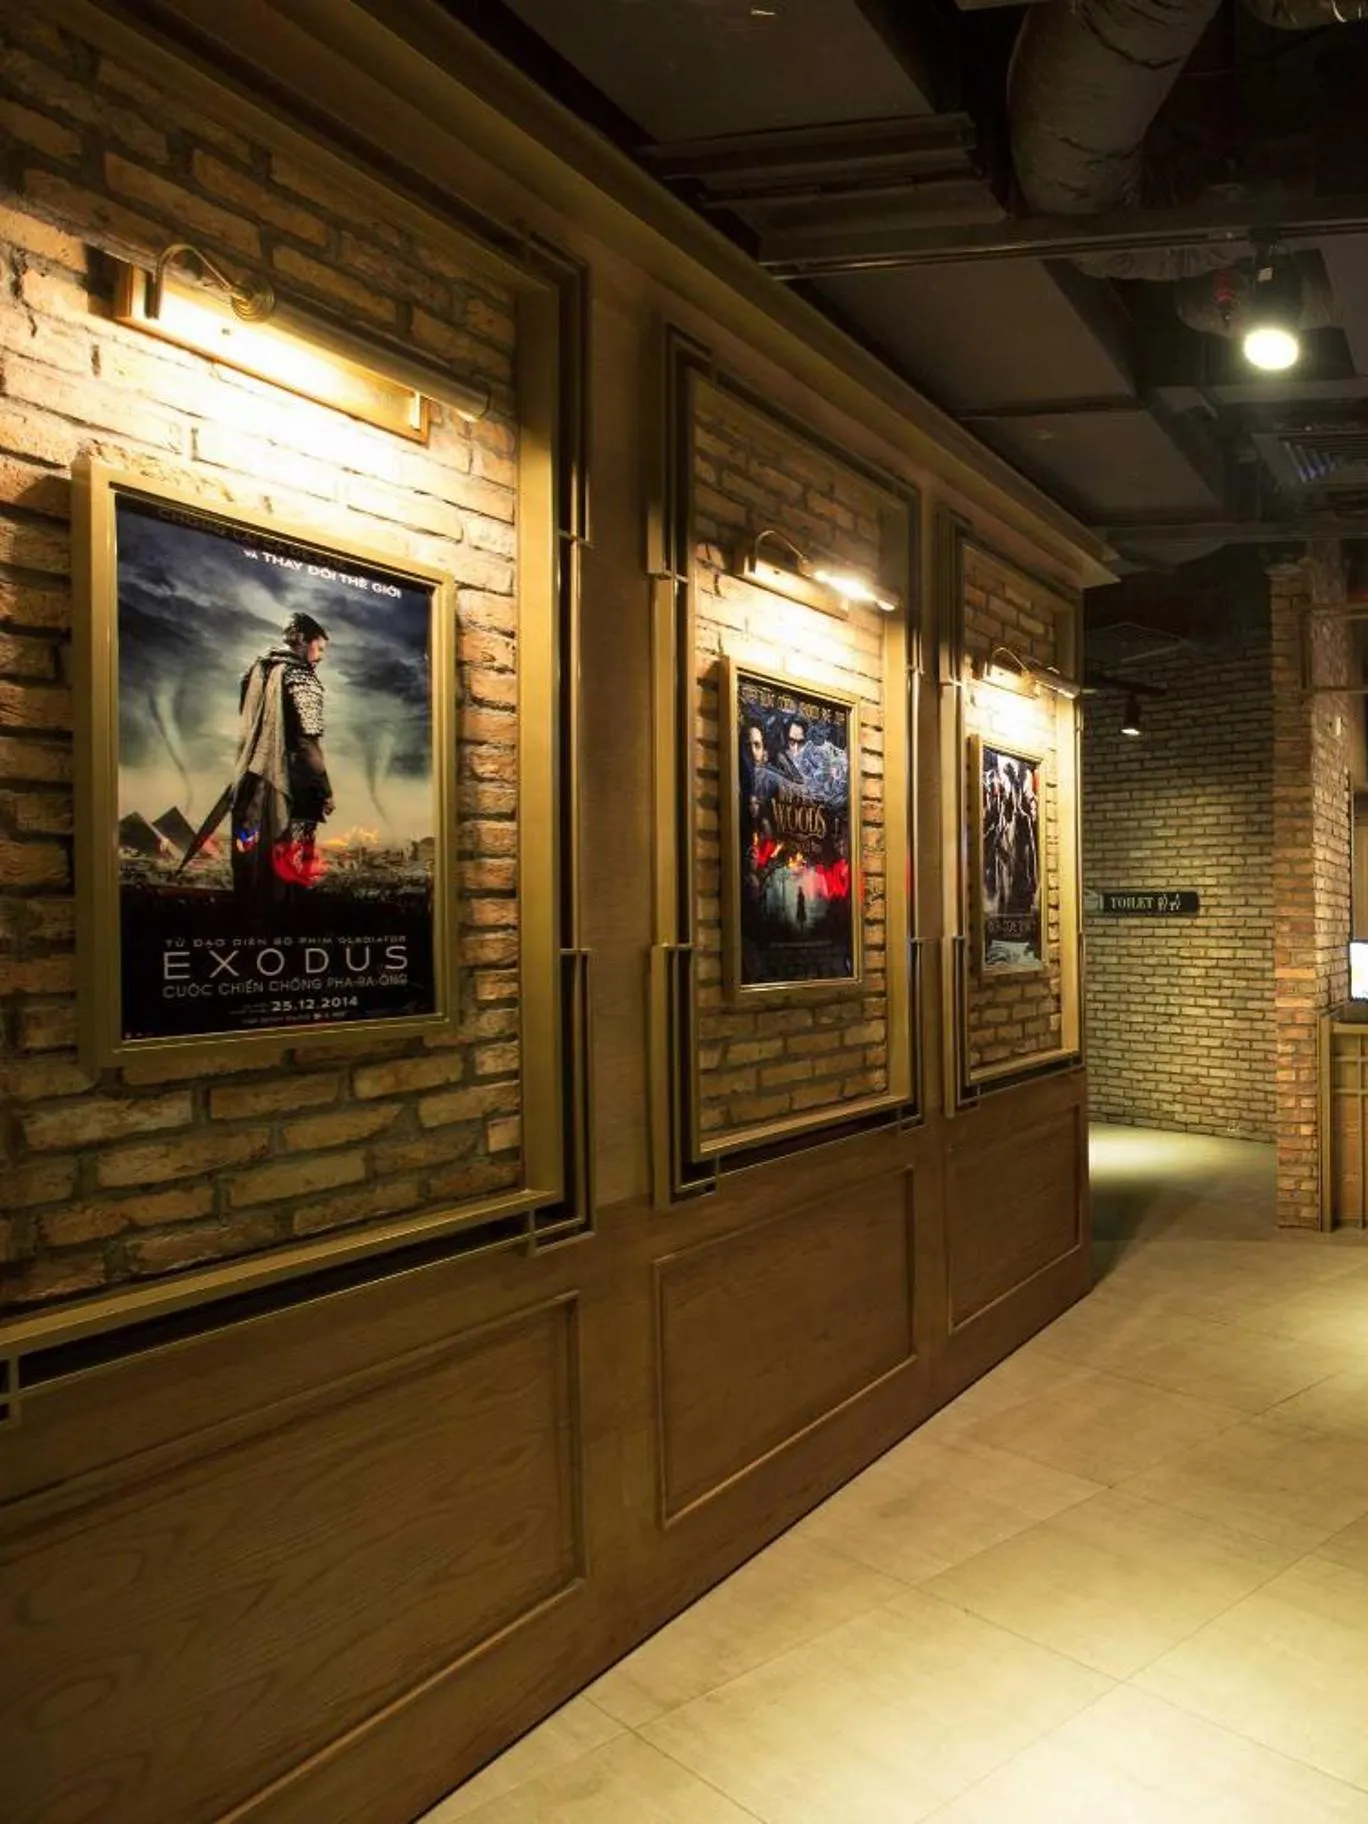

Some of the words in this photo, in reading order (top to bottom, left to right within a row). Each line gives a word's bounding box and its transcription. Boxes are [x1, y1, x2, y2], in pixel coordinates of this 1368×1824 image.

[262, 551, 303, 571] THAY
[1110, 895, 1154, 910] TOILET
[163, 945, 408, 980] EXODUS
[271, 995, 358, 1012] 25.12.2014
